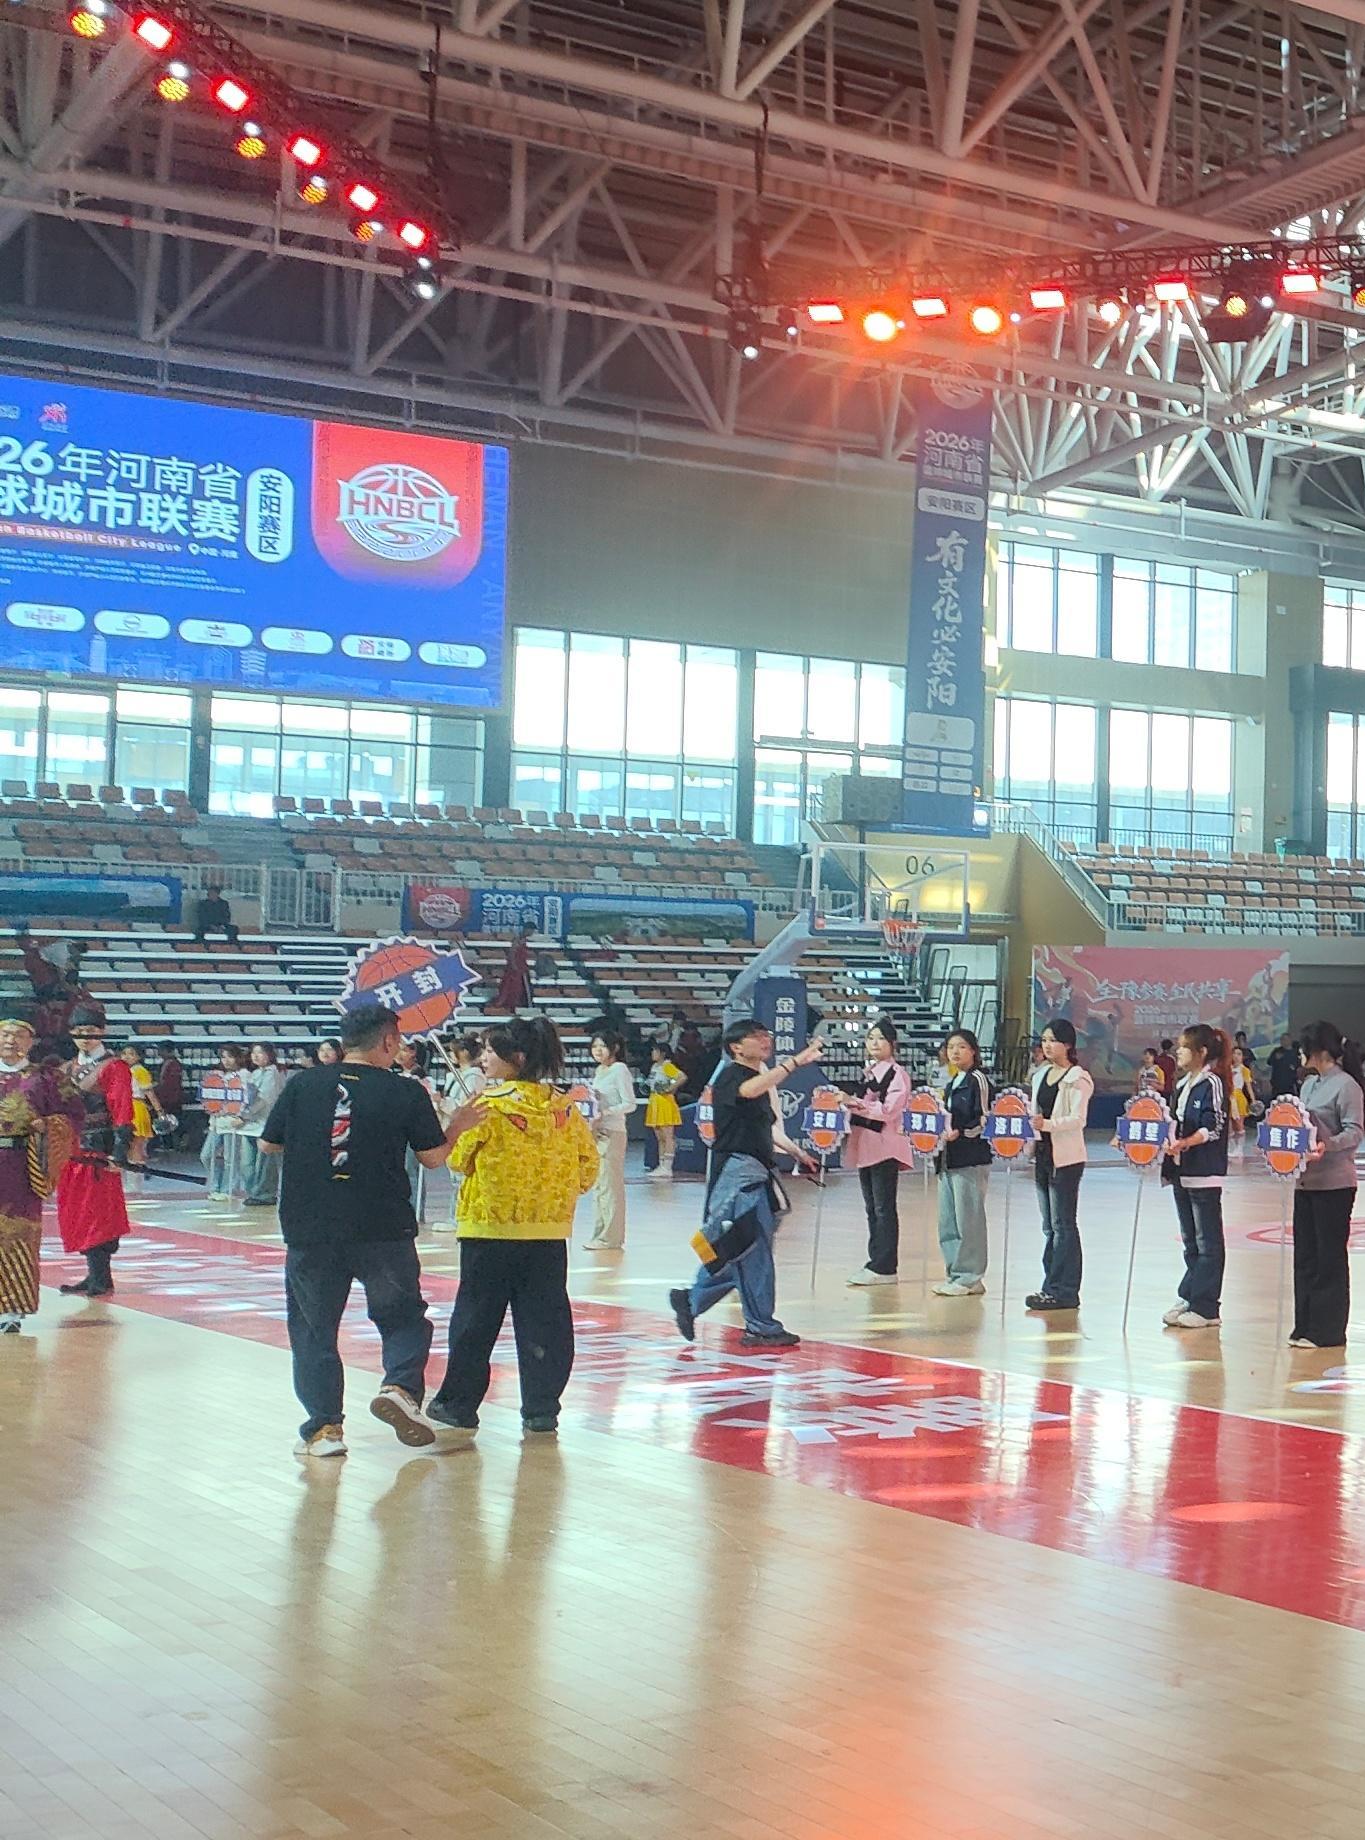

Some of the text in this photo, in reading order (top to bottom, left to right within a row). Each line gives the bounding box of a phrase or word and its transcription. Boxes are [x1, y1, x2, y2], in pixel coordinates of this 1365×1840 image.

[924, 429, 986, 455] 2026年
[923, 446, 984, 475] 河南省
[259, 473, 283, 556] 安阳赛区
[348, 494, 453, 527] HNBCL
[17, 525, 94, 545] Basketball
[97, 533, 127, 549] City
[131, 537, 183, 553] League
[906, 855, 935, 876] 06
[481, 892, 542, 909] 2026年
[374, 964, 443, 1009] 开封
[994, 1116, 1023, 1136] 洛阳
[1269, 1127, 1300, 1150] 焦作
